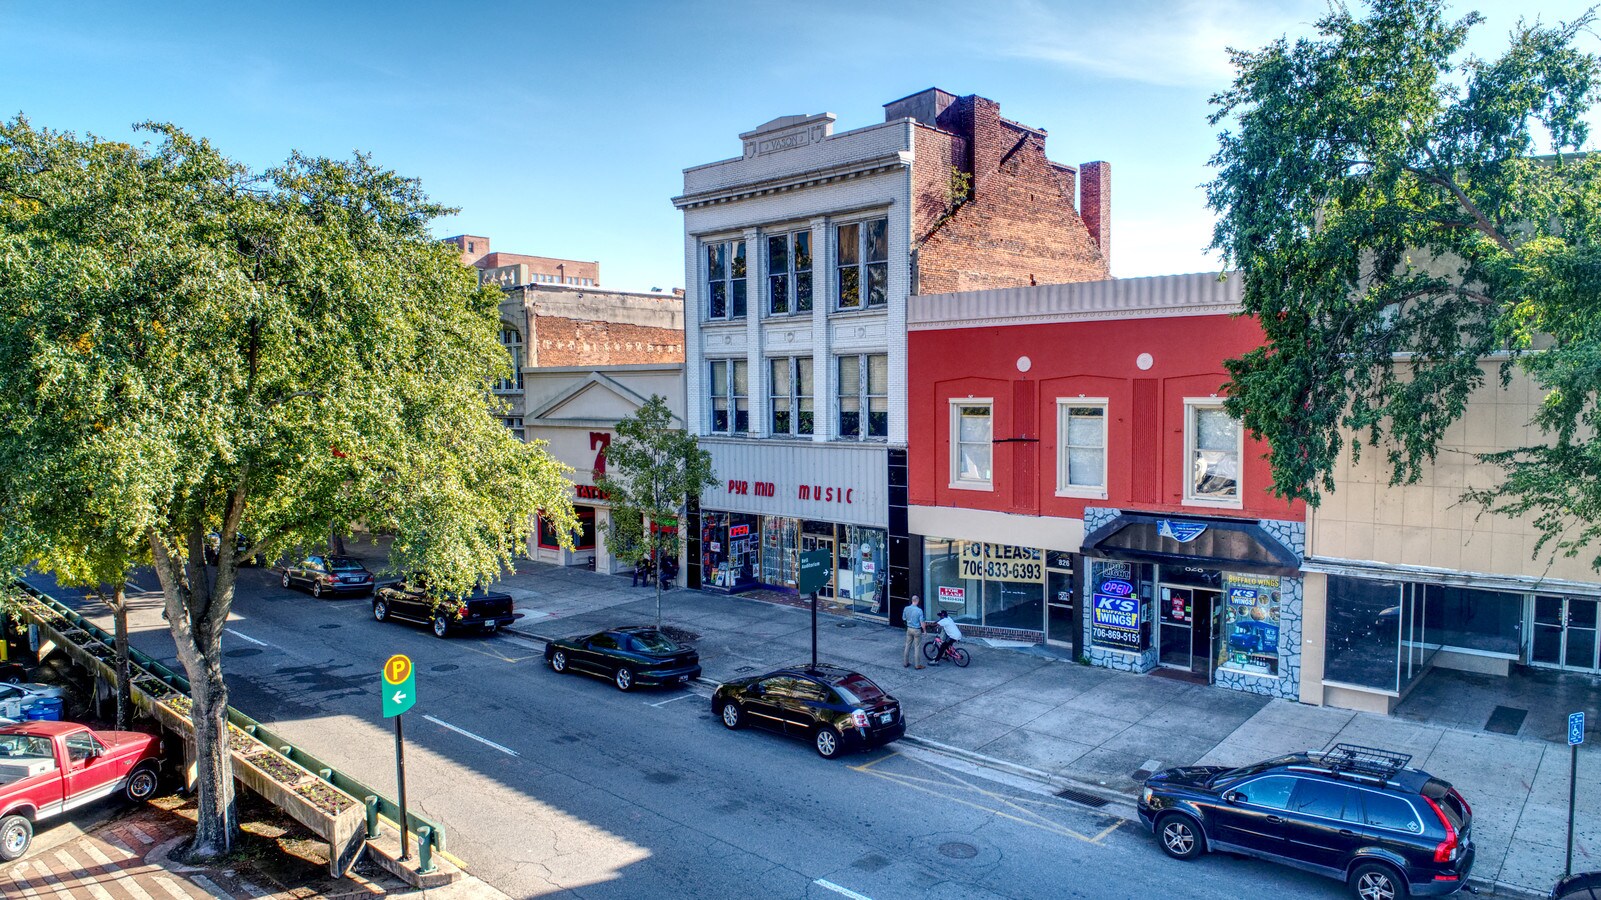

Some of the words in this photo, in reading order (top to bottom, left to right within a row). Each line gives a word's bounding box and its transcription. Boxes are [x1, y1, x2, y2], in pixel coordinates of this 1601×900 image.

[771, 135, 798, 150] VASON
[590, 432, 611, 482] 7
[799, 485, 853, 504] MUSIC
[730, 526, 749, 537] OPEN
[963, 542, 991, 558] FOR
[995, 544, 1041, 560] LEASE
[963, 560, 1041, 580] 706-833-6393
[1058, 559, 1070, 567] 826
[1228, 574, 1257, 585] BUFFALO
[1257, 579, 1279, 588] WINGS
[1104, 582, 1130, 595] OPEN
[1232, 589, 1255, 598] K'S
[1098, 598, 1135, 611] K'S
[1234, 596, 1253, 606] WINGS
[1101, 612, 1132, 626] WINGS
[1093, 627, 1140, 643] 706-869-5151
[392, 660, 406, 681] P
